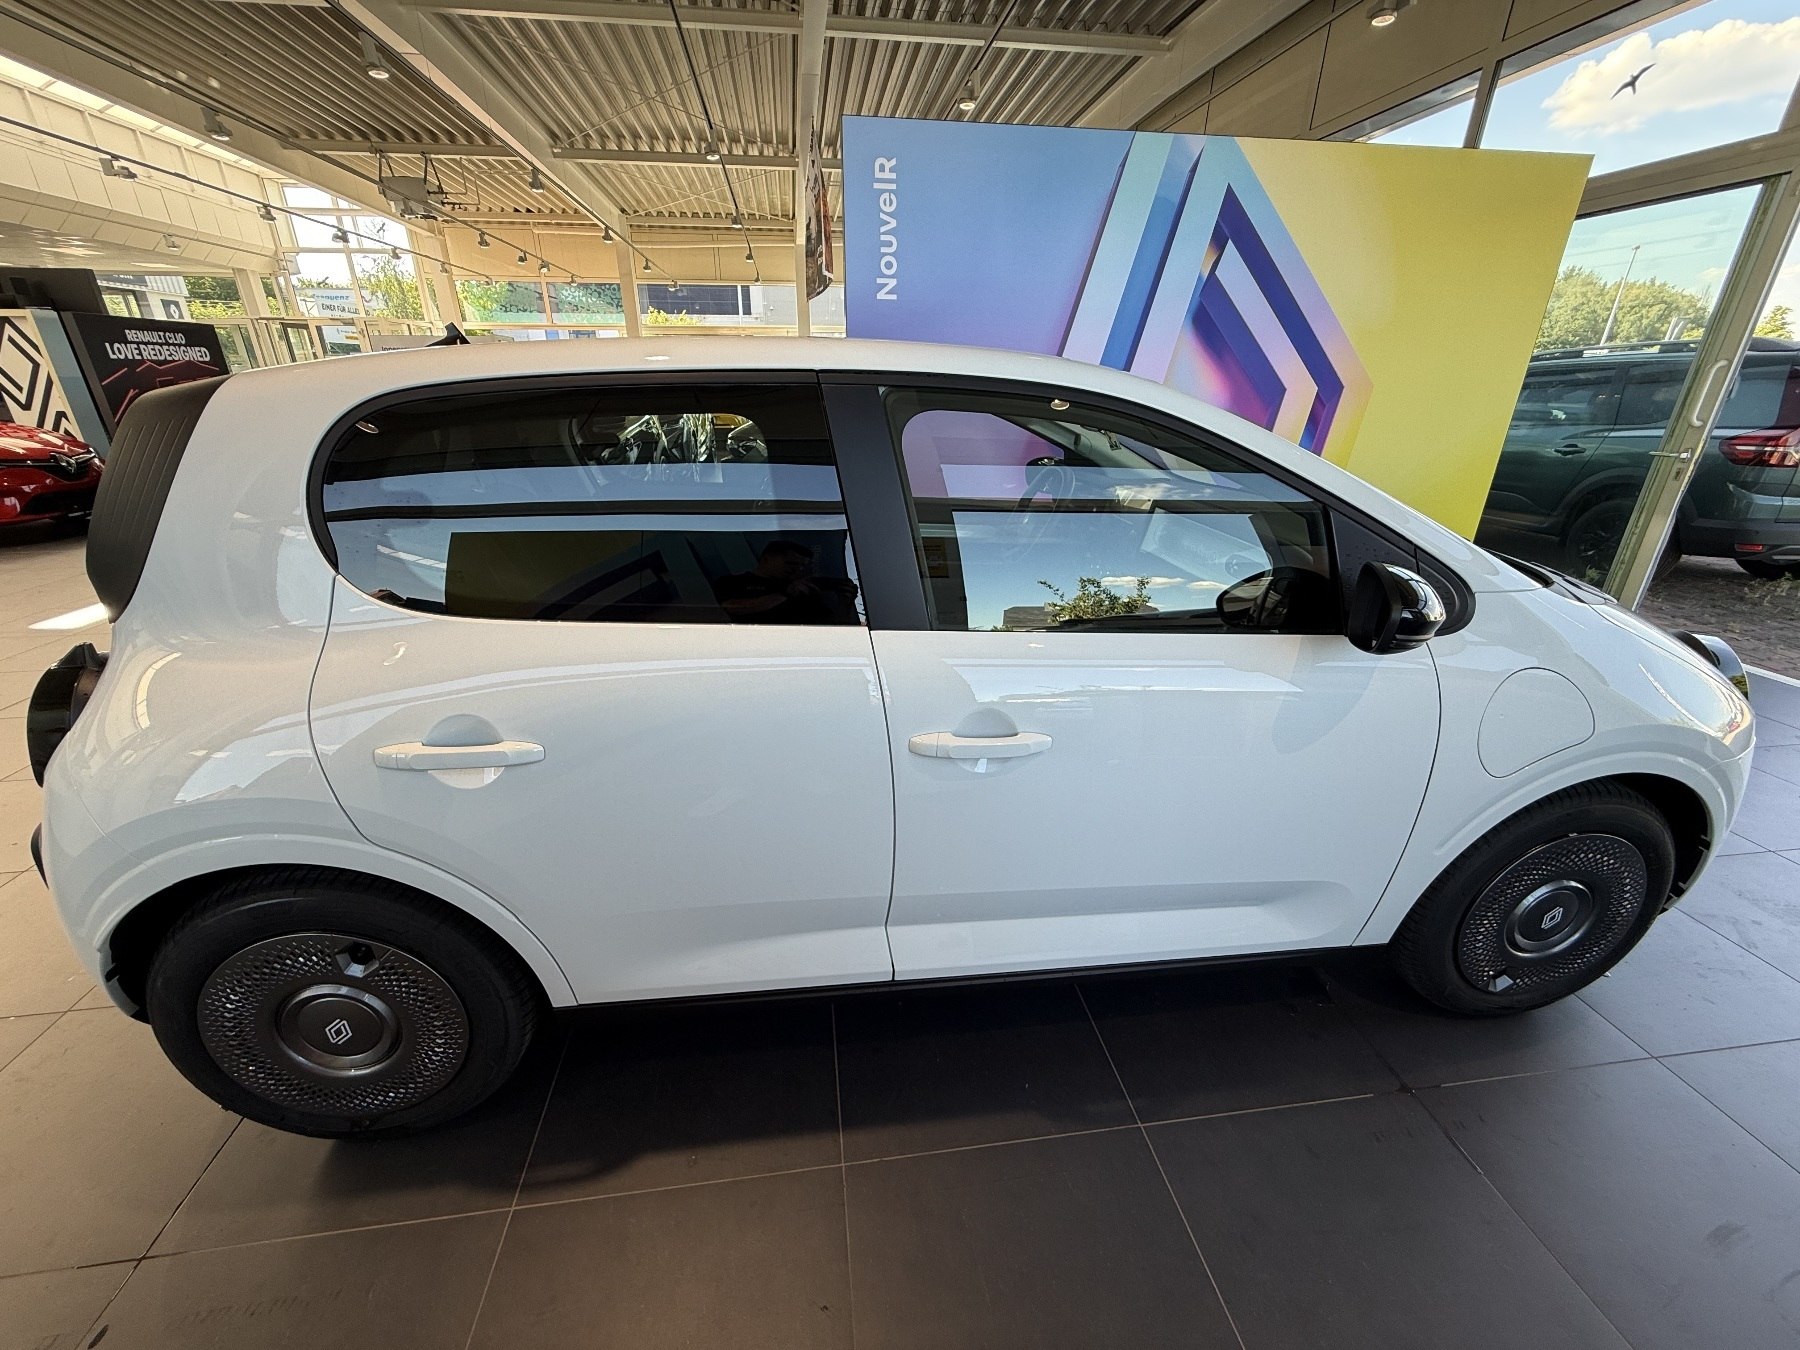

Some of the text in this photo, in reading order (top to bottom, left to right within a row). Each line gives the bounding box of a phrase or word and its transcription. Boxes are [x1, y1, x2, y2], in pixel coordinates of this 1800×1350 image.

[872, 156, 898, 300] NouvelR
[124, 329, 186, 345] RENAULT CLIO
[104, 342, 211, 362] LOVE REDESIGNED
